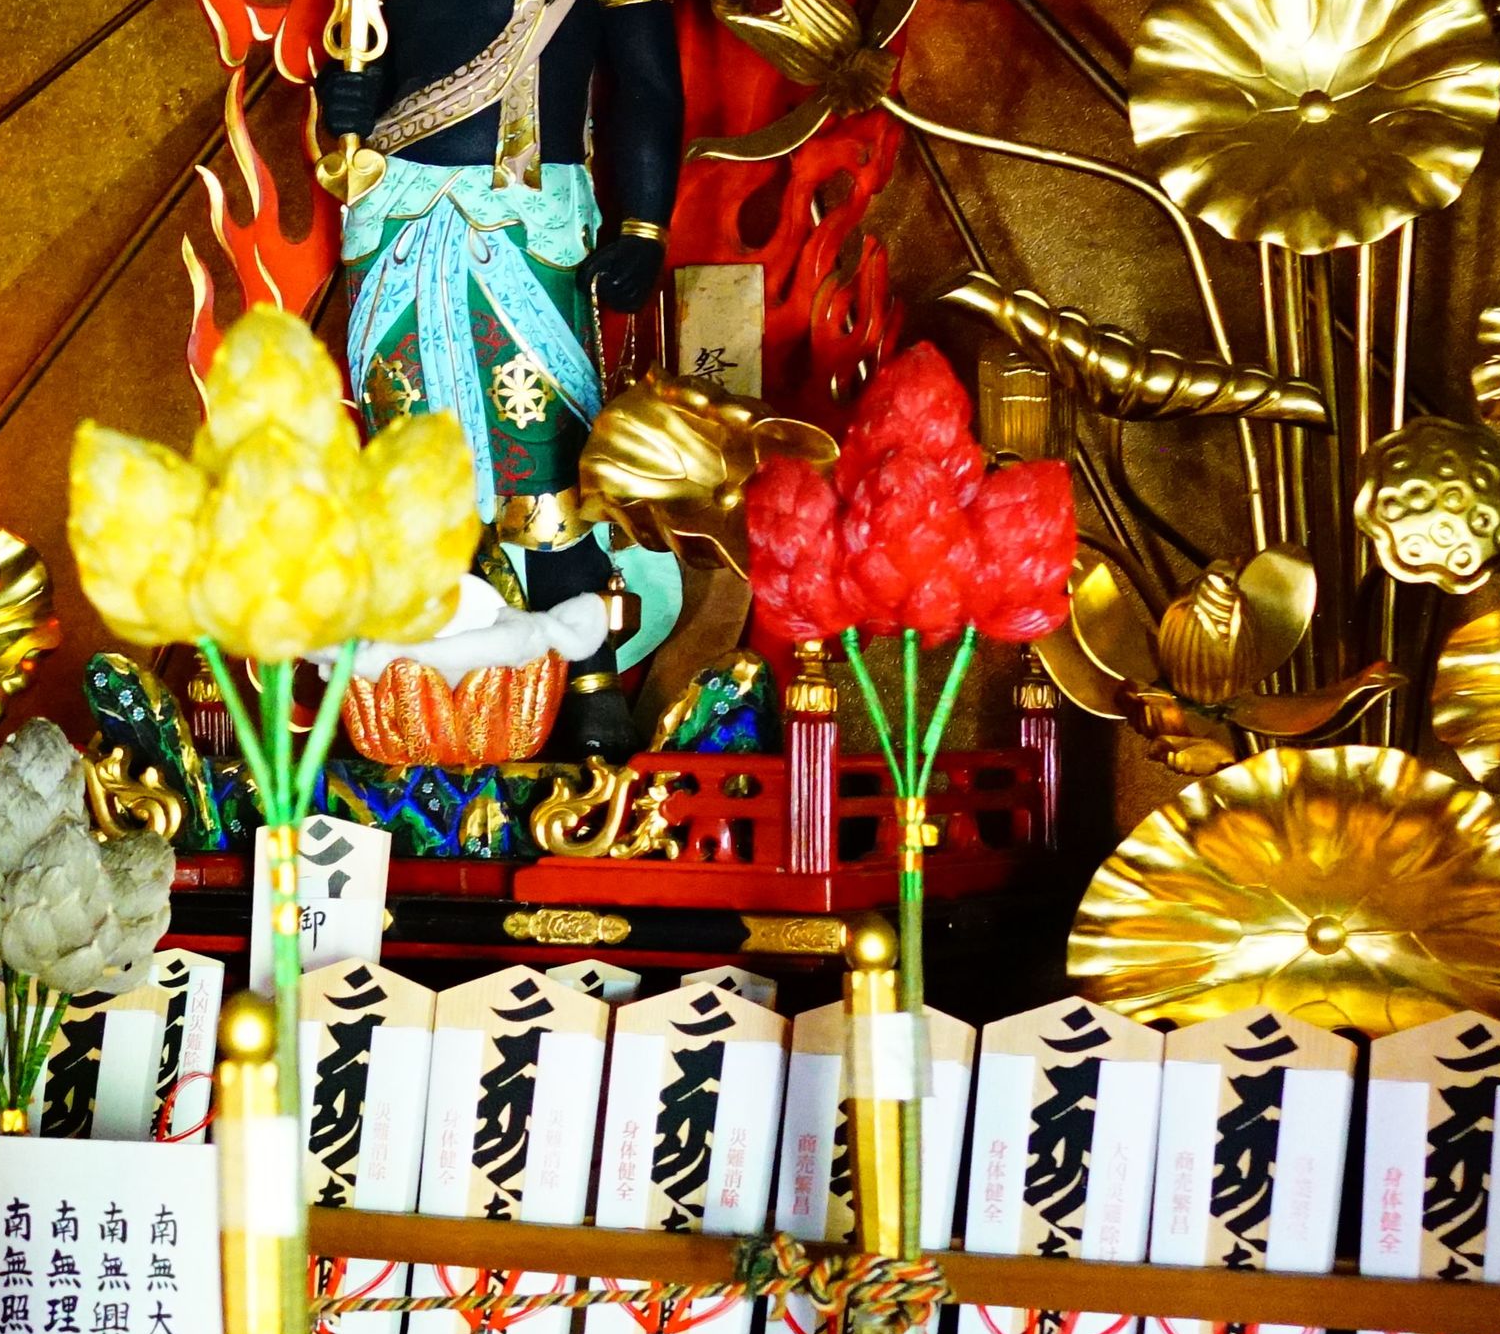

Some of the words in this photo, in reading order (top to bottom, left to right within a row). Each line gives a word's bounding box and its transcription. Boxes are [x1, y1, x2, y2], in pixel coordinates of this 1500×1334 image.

[614, 1118, 641, 1203] 身体健全
[718, 1127, 748, 1210] 災難消除
[983, 1138, 1010, 1223] 身体健全
[1166, 1150, 1197, 1237] 商売繁昌
[1377, 1165, 1405, 1257] 身体健全
